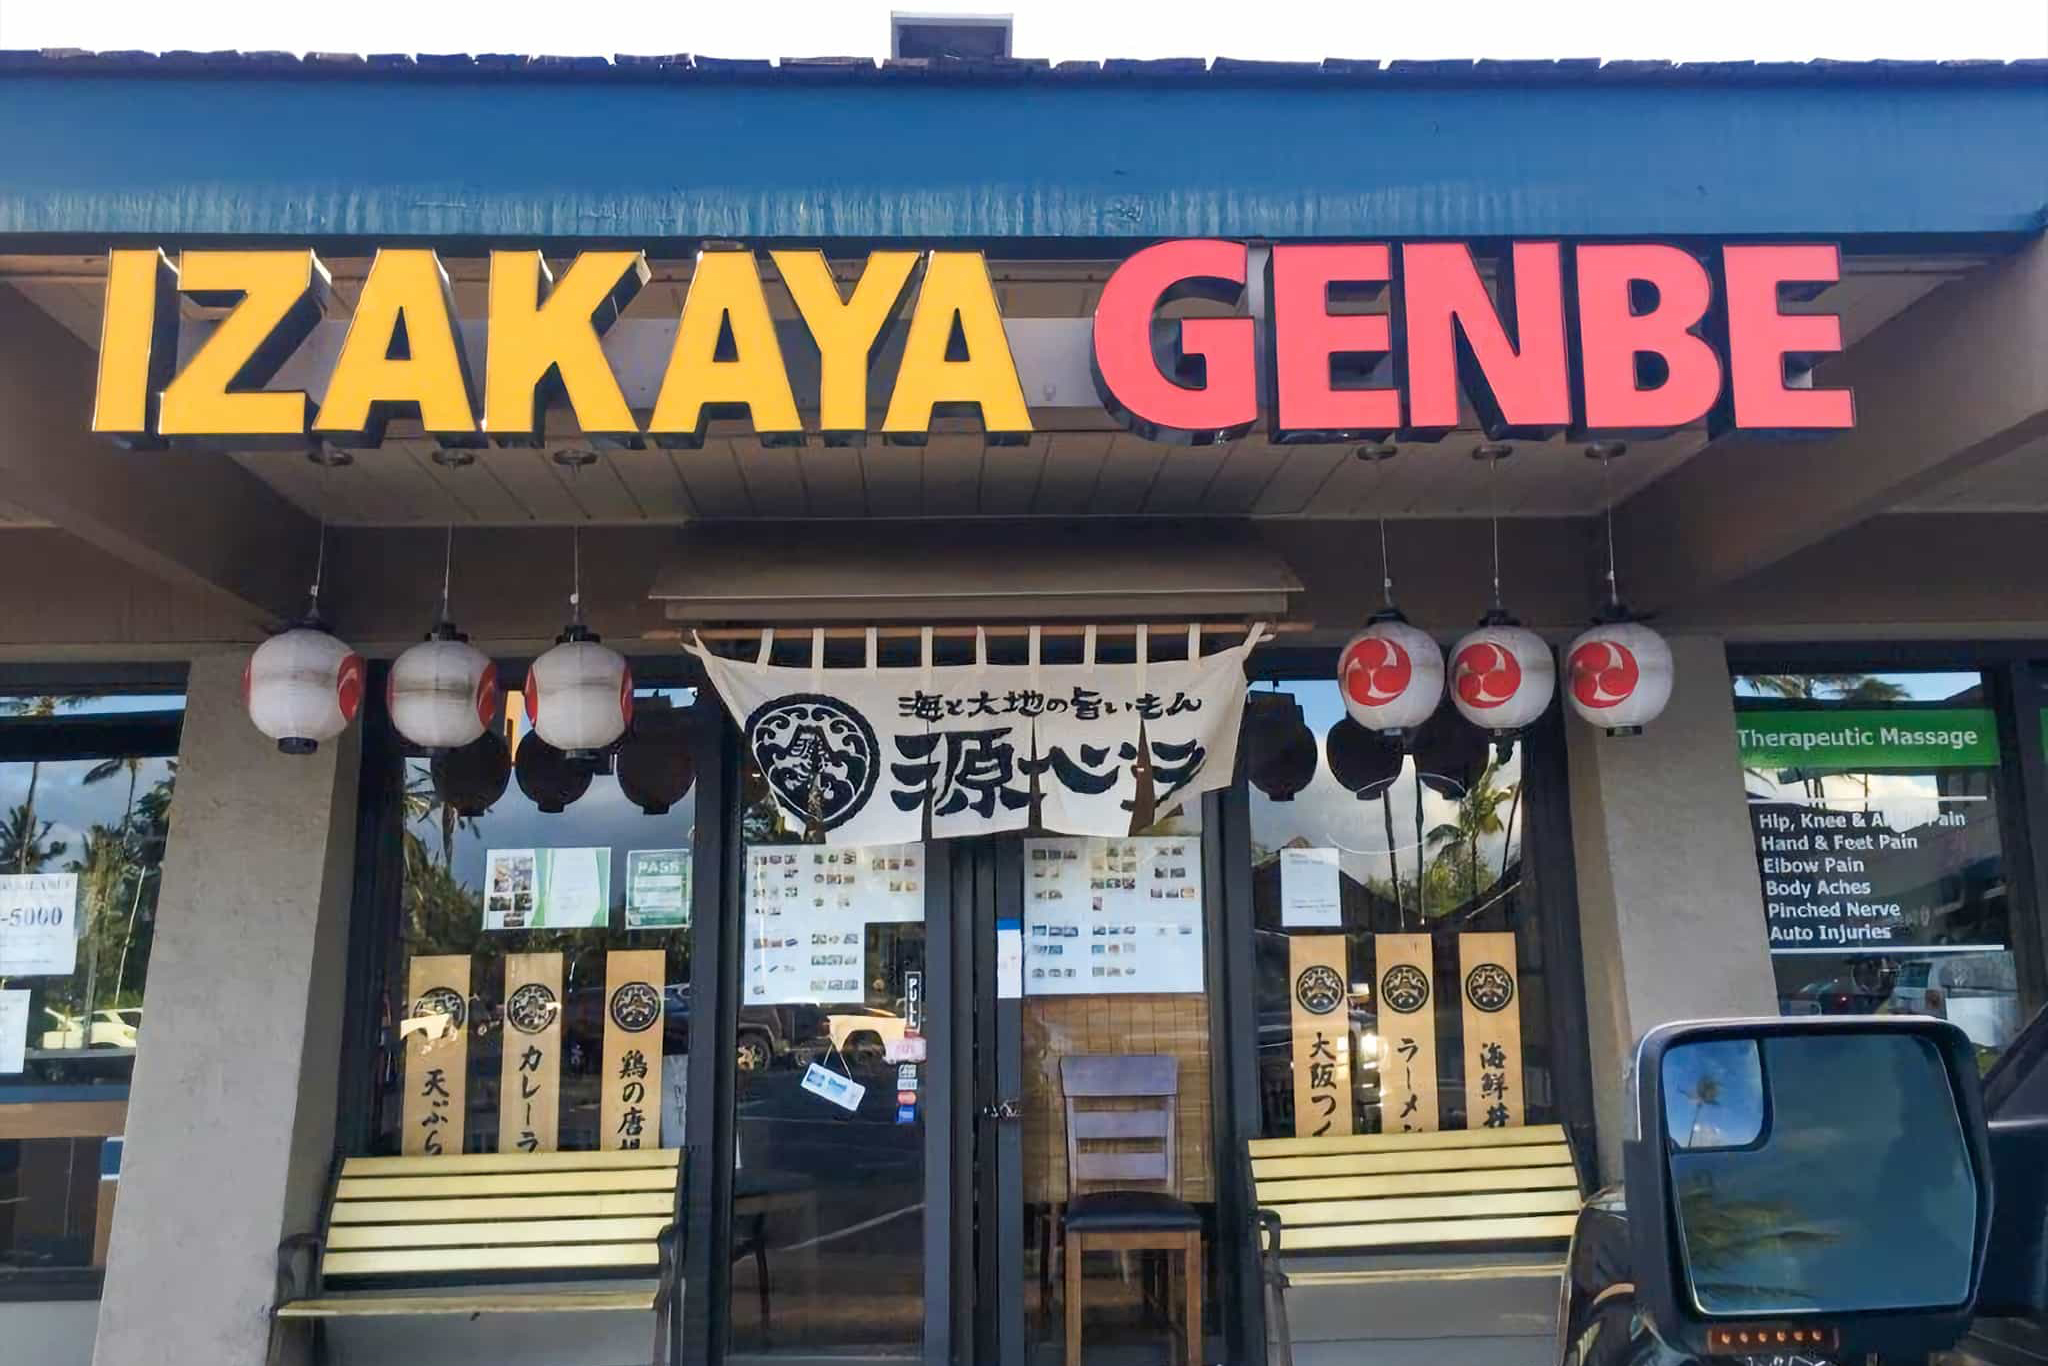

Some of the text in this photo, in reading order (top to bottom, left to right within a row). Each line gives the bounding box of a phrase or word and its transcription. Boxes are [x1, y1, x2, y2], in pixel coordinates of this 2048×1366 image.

[92, 240, 1855, 438] IZAKAYA GENBE
[1738, 728, 1977, 750] Therapeutic Massage
[1760, 812, 1796, 831] Hip,
[1801, 812, 1847, 828] Knee
[1853, 812, 1867, 828] &
[1927, 810, 1966, 827] ain
[1761, 833, 1918, 851] Hand & Feet Pain
[1763, 856, 1865, 874] Elbow Pain
[1766, 879, 1871, 899] Body Aches
[1768, 902, 1901, 919] Pinched Nerve
[1770, 924, 1892, 945] Auto Injuries
